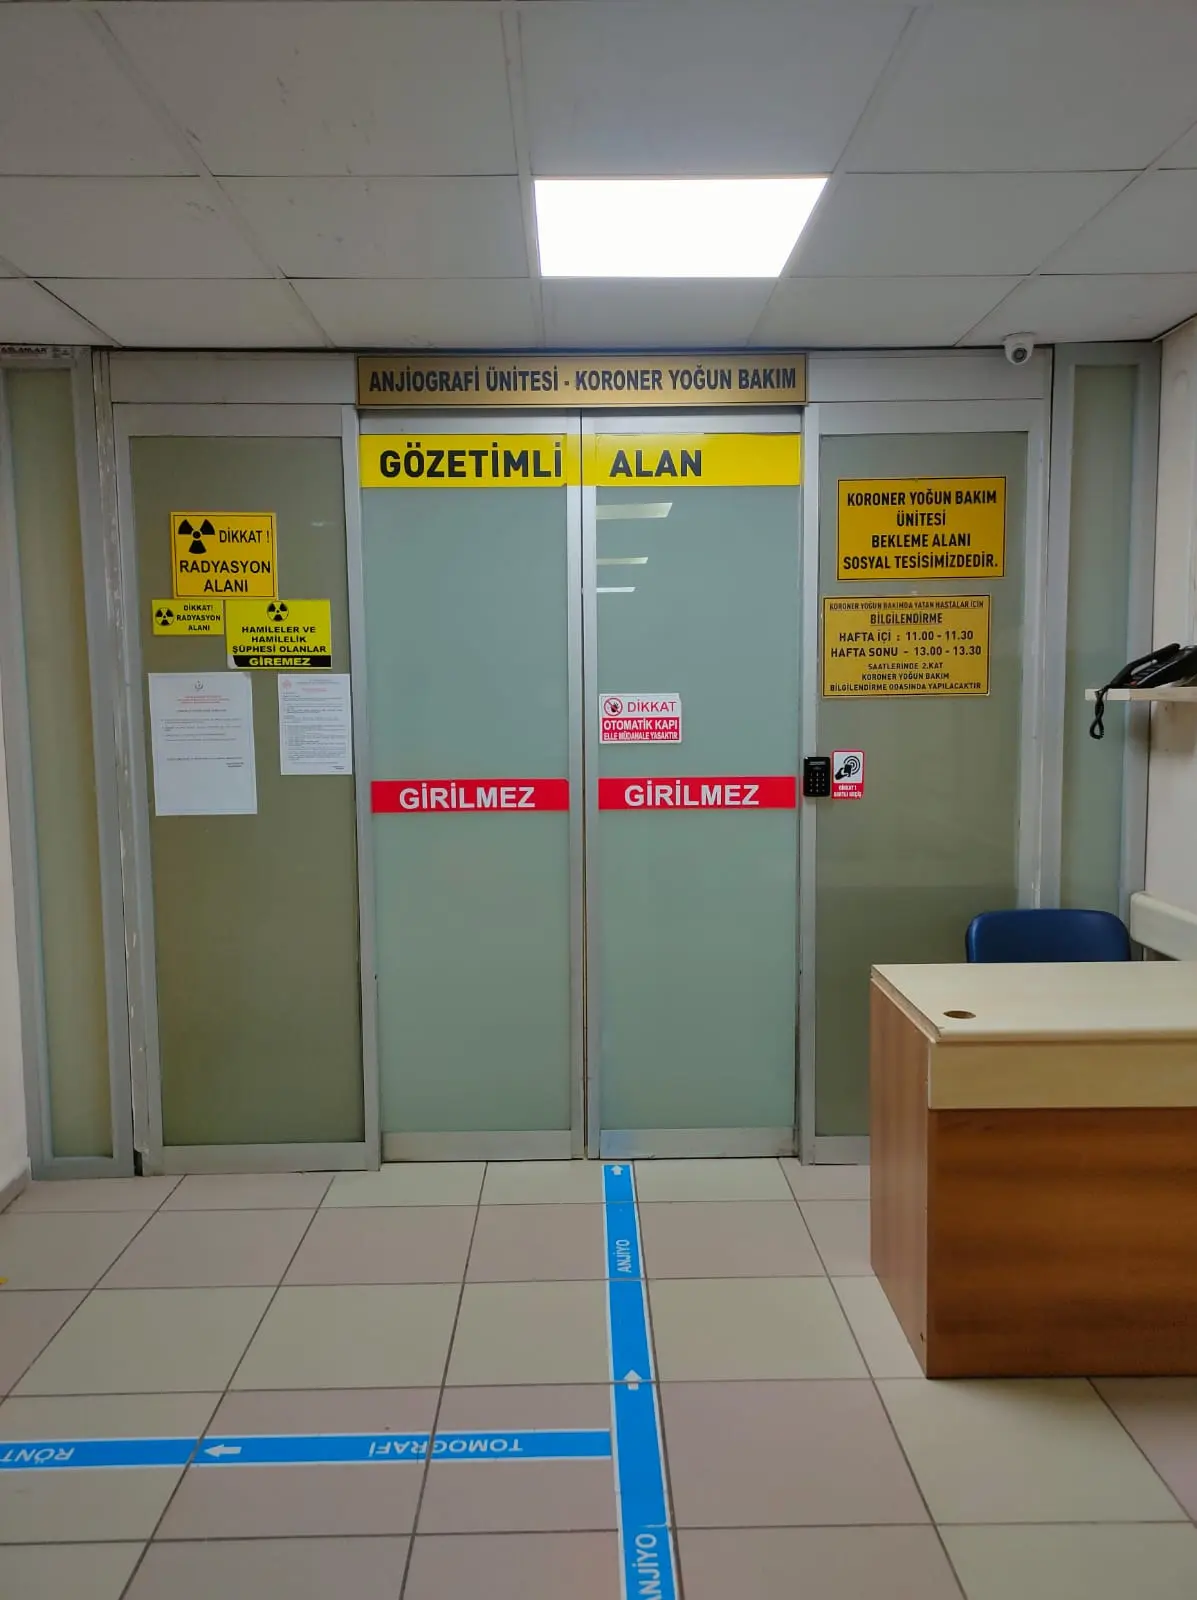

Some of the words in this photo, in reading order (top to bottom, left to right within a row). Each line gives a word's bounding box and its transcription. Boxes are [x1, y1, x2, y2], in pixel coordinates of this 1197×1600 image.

[369, 366, 480, 392] ANJİOGRAFİ
[486, 366, 559, 391] ÜNİTESİ
[575, 369, 663, 391] KORONER
[668, 365, 732, 390] YOĞUN
[738, 368, 796, 389] BAKIM
[380, 442, 562, 478] GÖZETİMLİ
[609, 450, 702, 477] ALAN
[847, 491, 906, 507] KORONER
[909, 489, 951, 505] YOĞUN
[955, 490, 997, 505] BAKIM
[896, 509, 946, 527] ÜNİTESİ
[219, 526, 263, 544] DİKKAT
[871, 534, 929, 548] BEKLEME
[932, 533, 971, 547] ALANI
[180, 560, 271, 574] RADYASYON
[843, 555, 891, 570] SOSYAL
[894, 551, 998, 569] TESİSİMİZDEDİR.
[204, 579, 248, 593] ALANI
[829, 602, 859, 611] KORONER
[935, 600, 969, 609] HASTALAR
[176, 614, 221, 622] RADYASYON
[870, 611, 943, 625] BİLGİLENDİRME
[188, 624, 210, 632] ALANI
[241, 625, 300, 634] HAMİLELER
[251, 634, 306, 643] HAMİLELİK
[839, 631, 875, 642] HAFTA
[877, 630, 891, 644] İÇİ
[905, 631, 934, 641] 11.00
[945, 630, 973, 640] 11.30
[232, 645, 276, 655] ŞÜPHESİ
[279, 645, 326, 653] OLANLAR
[831, 648, 866, 658] HAFTA
[869, 647, 898, 657] SONU
[914, 647, 942, 656] 13.00
[954, 646, 982, 656] 13.30
[249, 656, 311, 666] GİREMEZ
[868, 662, 919, 670] SAATLERİNDE
[861, 673, 896, 681] KORONER
[899, 671, 924, 680] YOĞUN
[925, 672, 950, 680] BAKIM
[830, 683, 887, 692] BİLGİLENDİRME
[888, 683, 926, 691] ODASINDA
[928, 682, 981, 690] YAPILACAKTIR
[627, 699, 677, 713] DİKKAT
[604, 717, 653, 730] OTOMATİK
[655, 719, 677, 730] KAPI
[604, 732, 618, 740] ELLE
[400, 782, 535, 809] GİRİLMEZ
[624, 780, 760, 806] GİRİLMEZ
[612, 1239, 632, 1274] ANJİYO
[368, 1438, 524, 1458] TOMOGRAFİ
[0, 1447, 75, 1464] RÖNT
